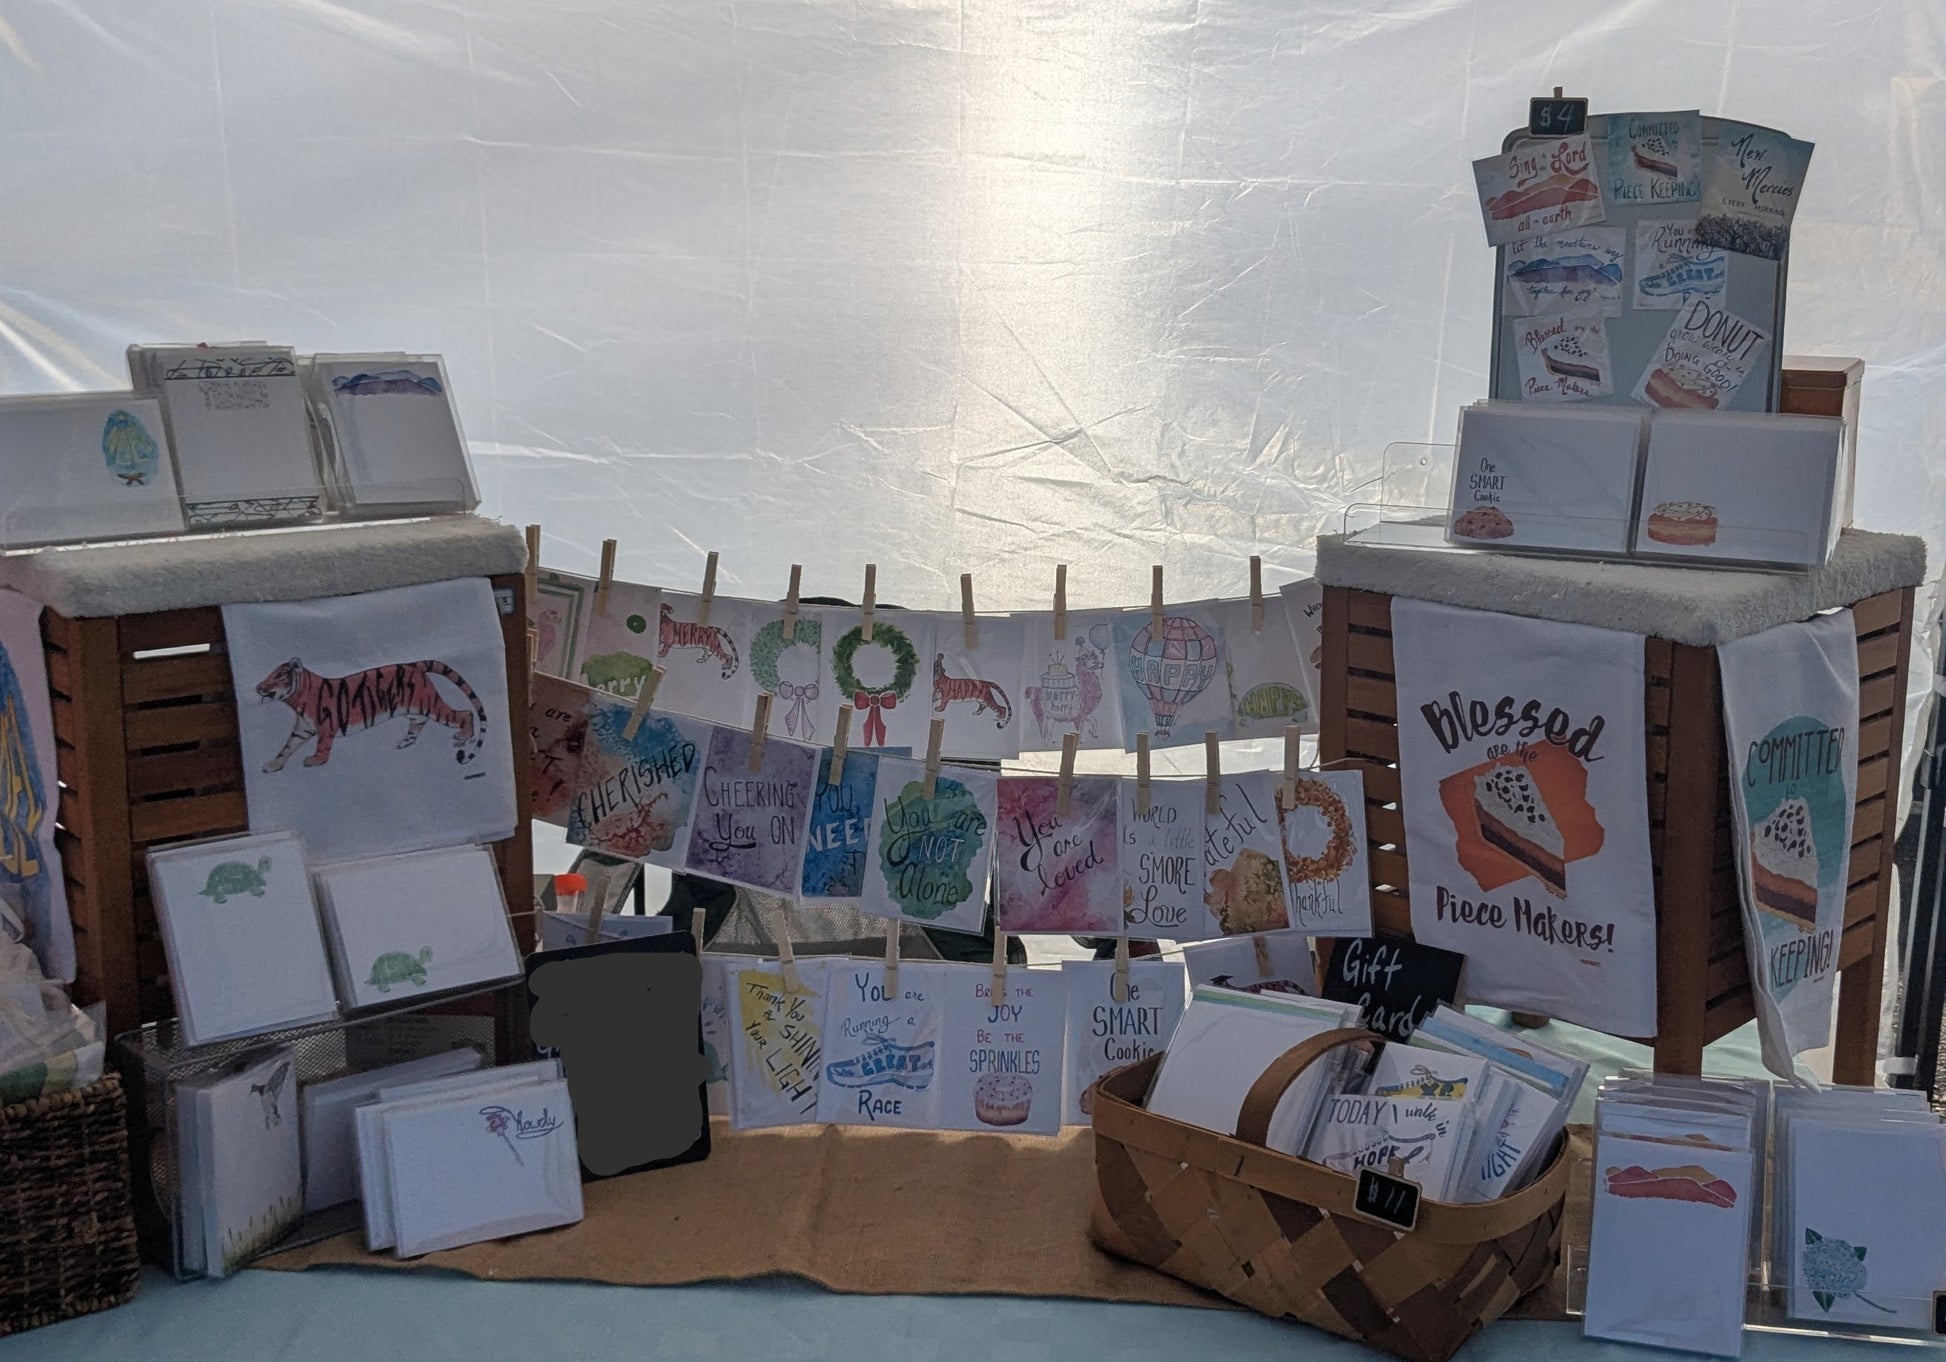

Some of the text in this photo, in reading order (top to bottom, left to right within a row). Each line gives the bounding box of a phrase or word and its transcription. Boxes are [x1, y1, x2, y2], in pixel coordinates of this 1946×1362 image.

[1508, 156, 1539, 188] Sing
[1550, 141, 1590, 176] Lord
[1741, 165, 1795, 205] Mercies
[1543, 206, 1572, 226] earth
[1684, 299, 1765, 361] DONUT
[1469, 473, 1507, 490] SMART
[1480, 457, 1496, 473] One
[1130, 654, 1214, 690] HAPPY
[1419, 690, 1607, 763] Blessed
[577, 742, 696, 832] CHERISHED
[709, 813, 796, 851] You ON
[883, 795, 934, 867] You
[953, 810, 988, 837] are
[1012, 808, 1063, 873] You
[1204, 782, 1268, 867] ateful
[918, 836, 966, 863] NOT
[1053, 833, 1084, 858] are
[1436, 885, 1507, 929] Piece
[1342, 937, 1402, 991] Gift
[1770, 928, 1834, 989] KEEPING!
[904, 991, 925, 1002] are
[987, 1004, 1023, 1023] JOY
[1092, 1005, 1164, 1037] SMART
[969, 1049, 1041, 1075] SPRINKLES
[1328, 1099, 1388, 1126] TODAY
